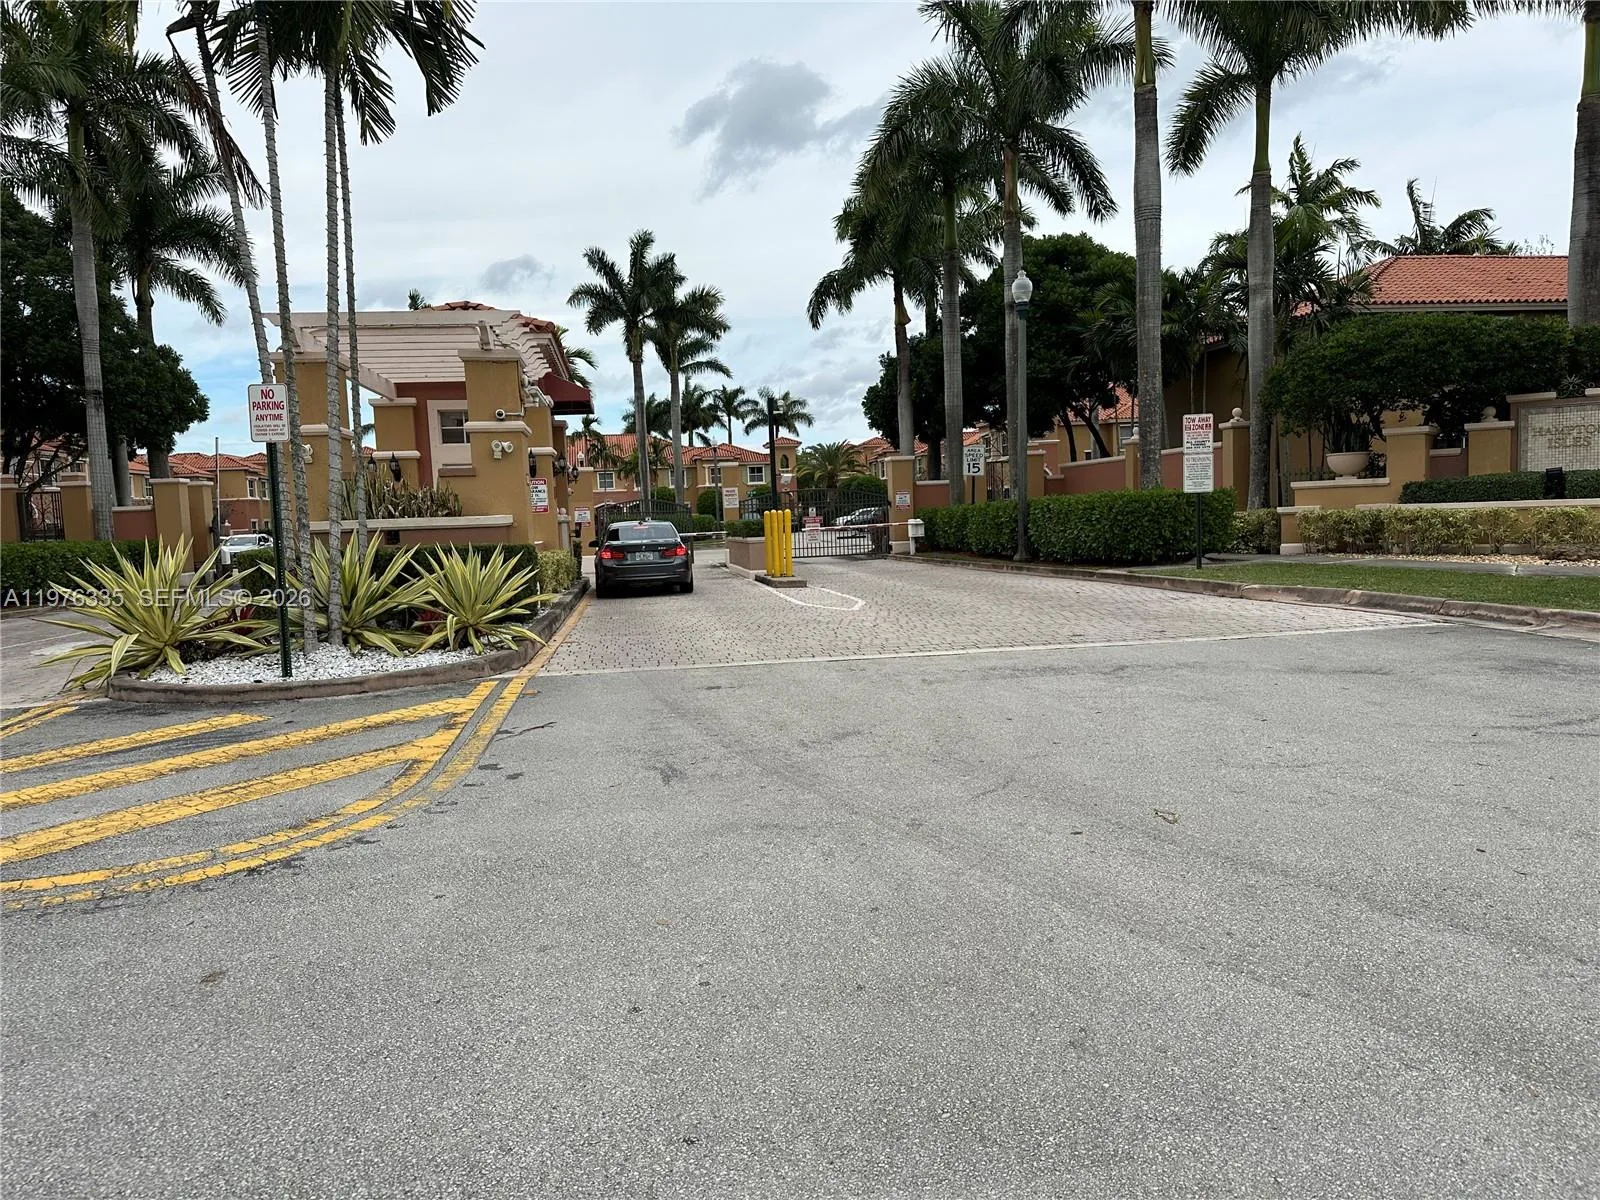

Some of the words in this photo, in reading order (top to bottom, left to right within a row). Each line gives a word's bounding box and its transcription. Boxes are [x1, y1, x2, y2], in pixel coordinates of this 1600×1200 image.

[260, 389, 275, 399] NO
[252, 401, 285, 410] PARKING
[967, 463, 980, 473] 15
